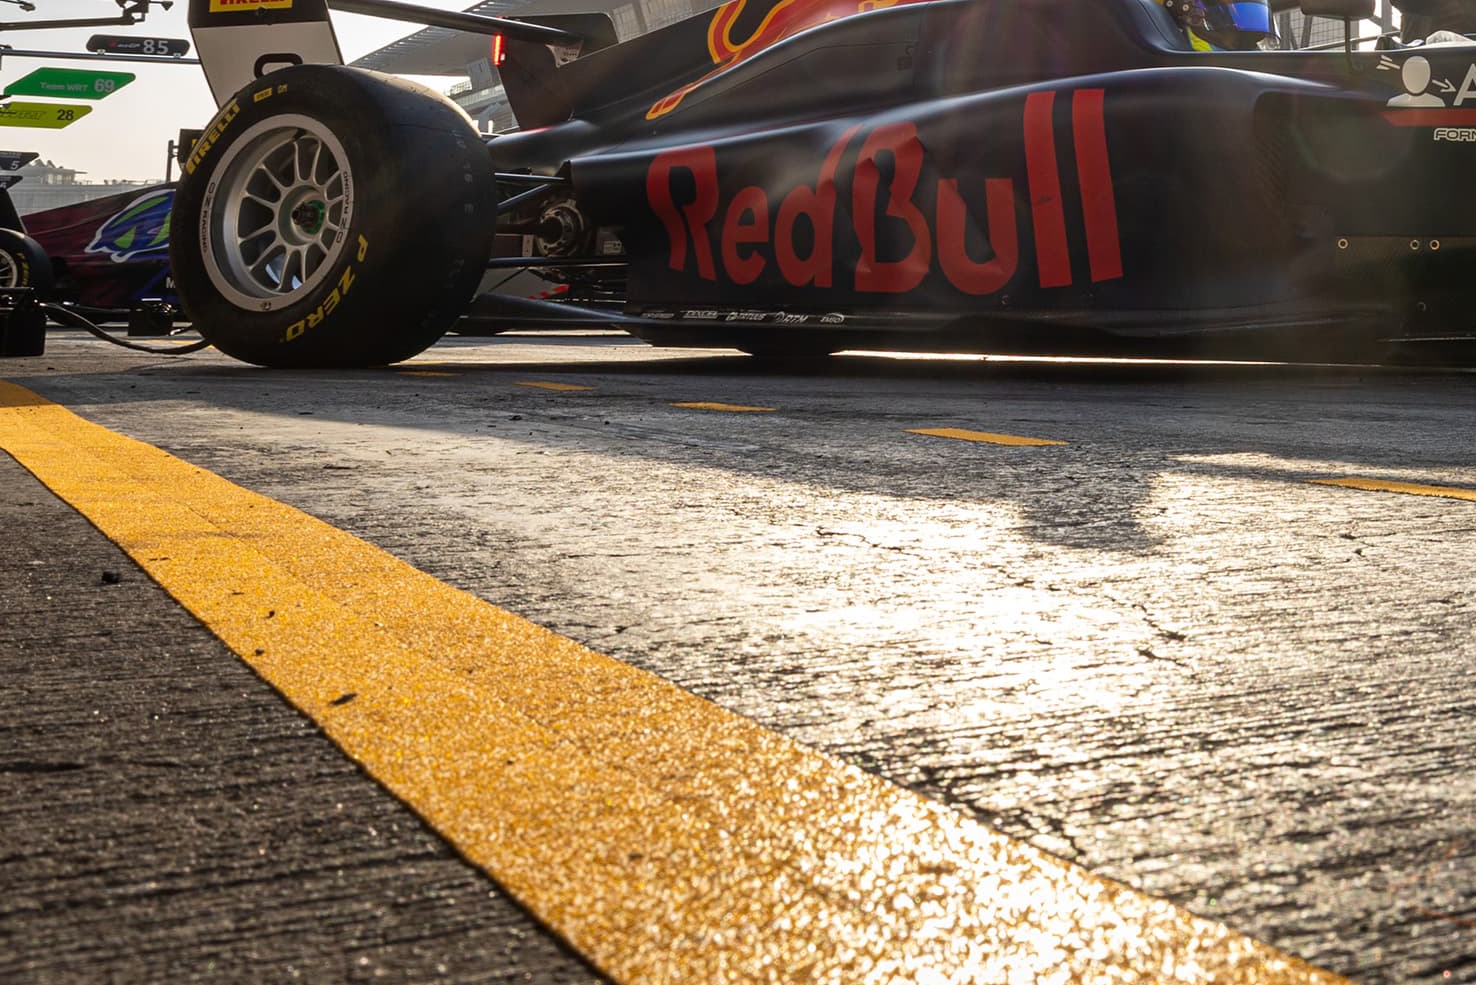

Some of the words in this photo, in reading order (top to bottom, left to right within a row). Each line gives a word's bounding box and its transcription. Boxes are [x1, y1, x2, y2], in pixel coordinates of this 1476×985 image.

[143, 39, 169, 55] 85
[94, 78, 115, 93] 69
[57, 109, 74, 120] 28
[185, 97, 241, 175] PIRELLI
[646, 124, 865, 289] Red
[853, 89, 1124, 295] Bull
[357, 234, 368, 262] P
[286, 265, 356, 342] ZERO
